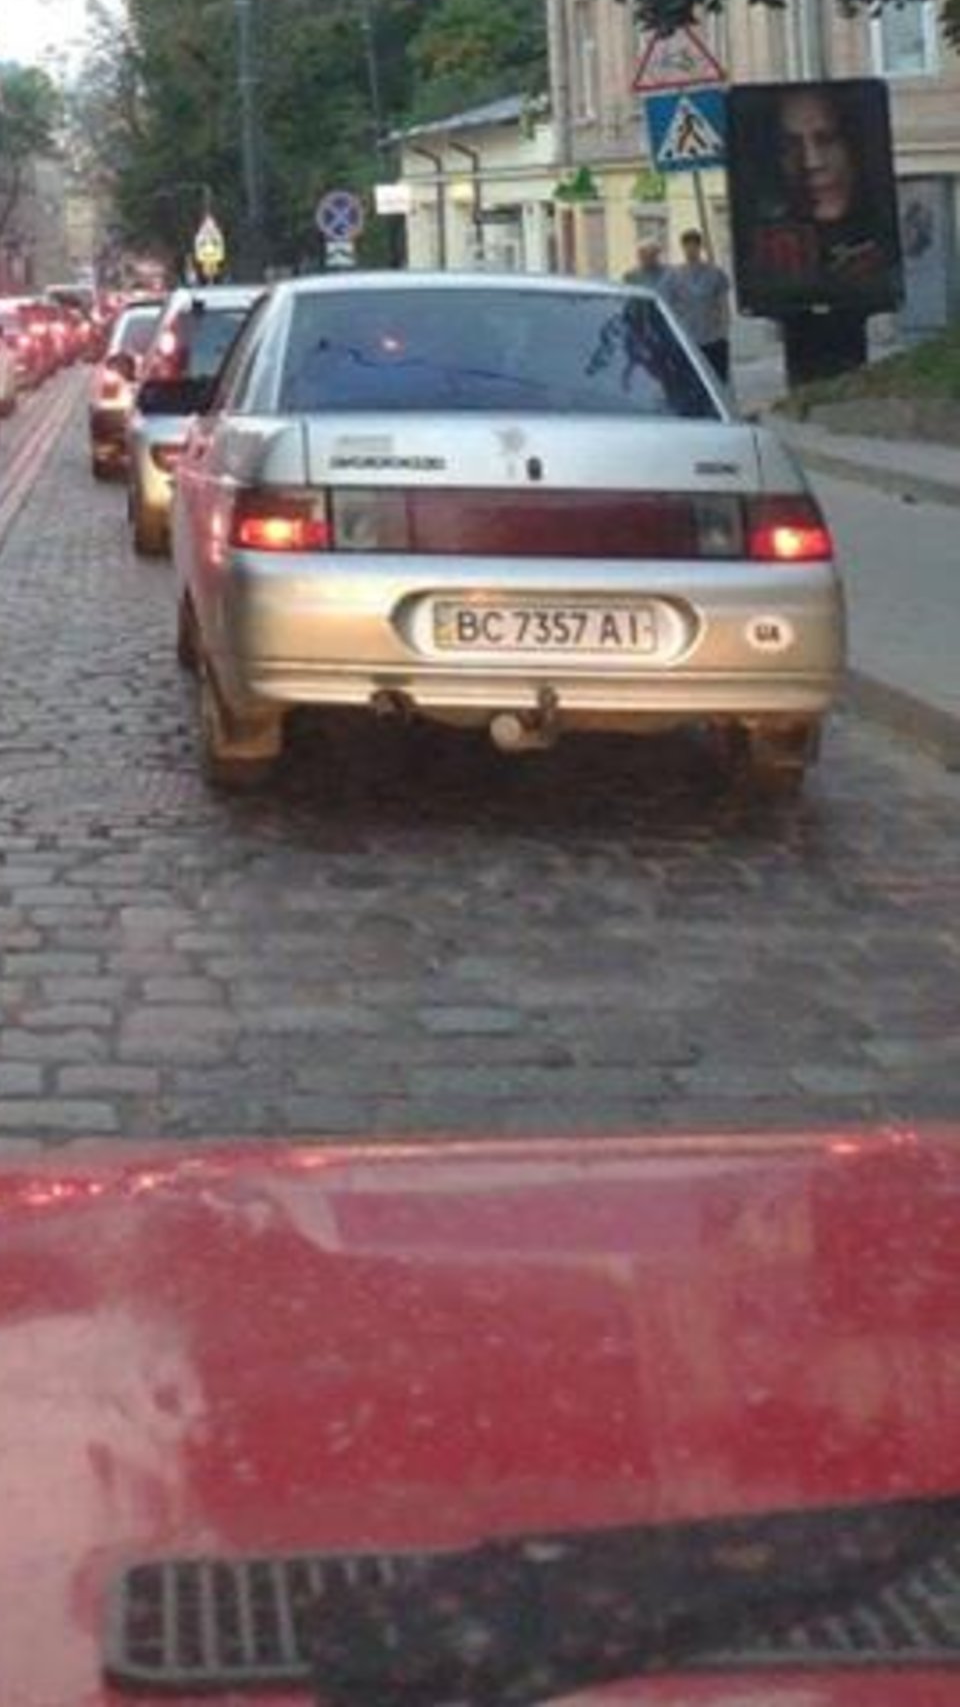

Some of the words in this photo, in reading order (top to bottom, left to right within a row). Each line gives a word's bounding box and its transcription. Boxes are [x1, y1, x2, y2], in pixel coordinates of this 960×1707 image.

[456, 611, 503, 644] BC
[512, 610, 588, 644] 7357
[599, 612, 638, 645] AI
